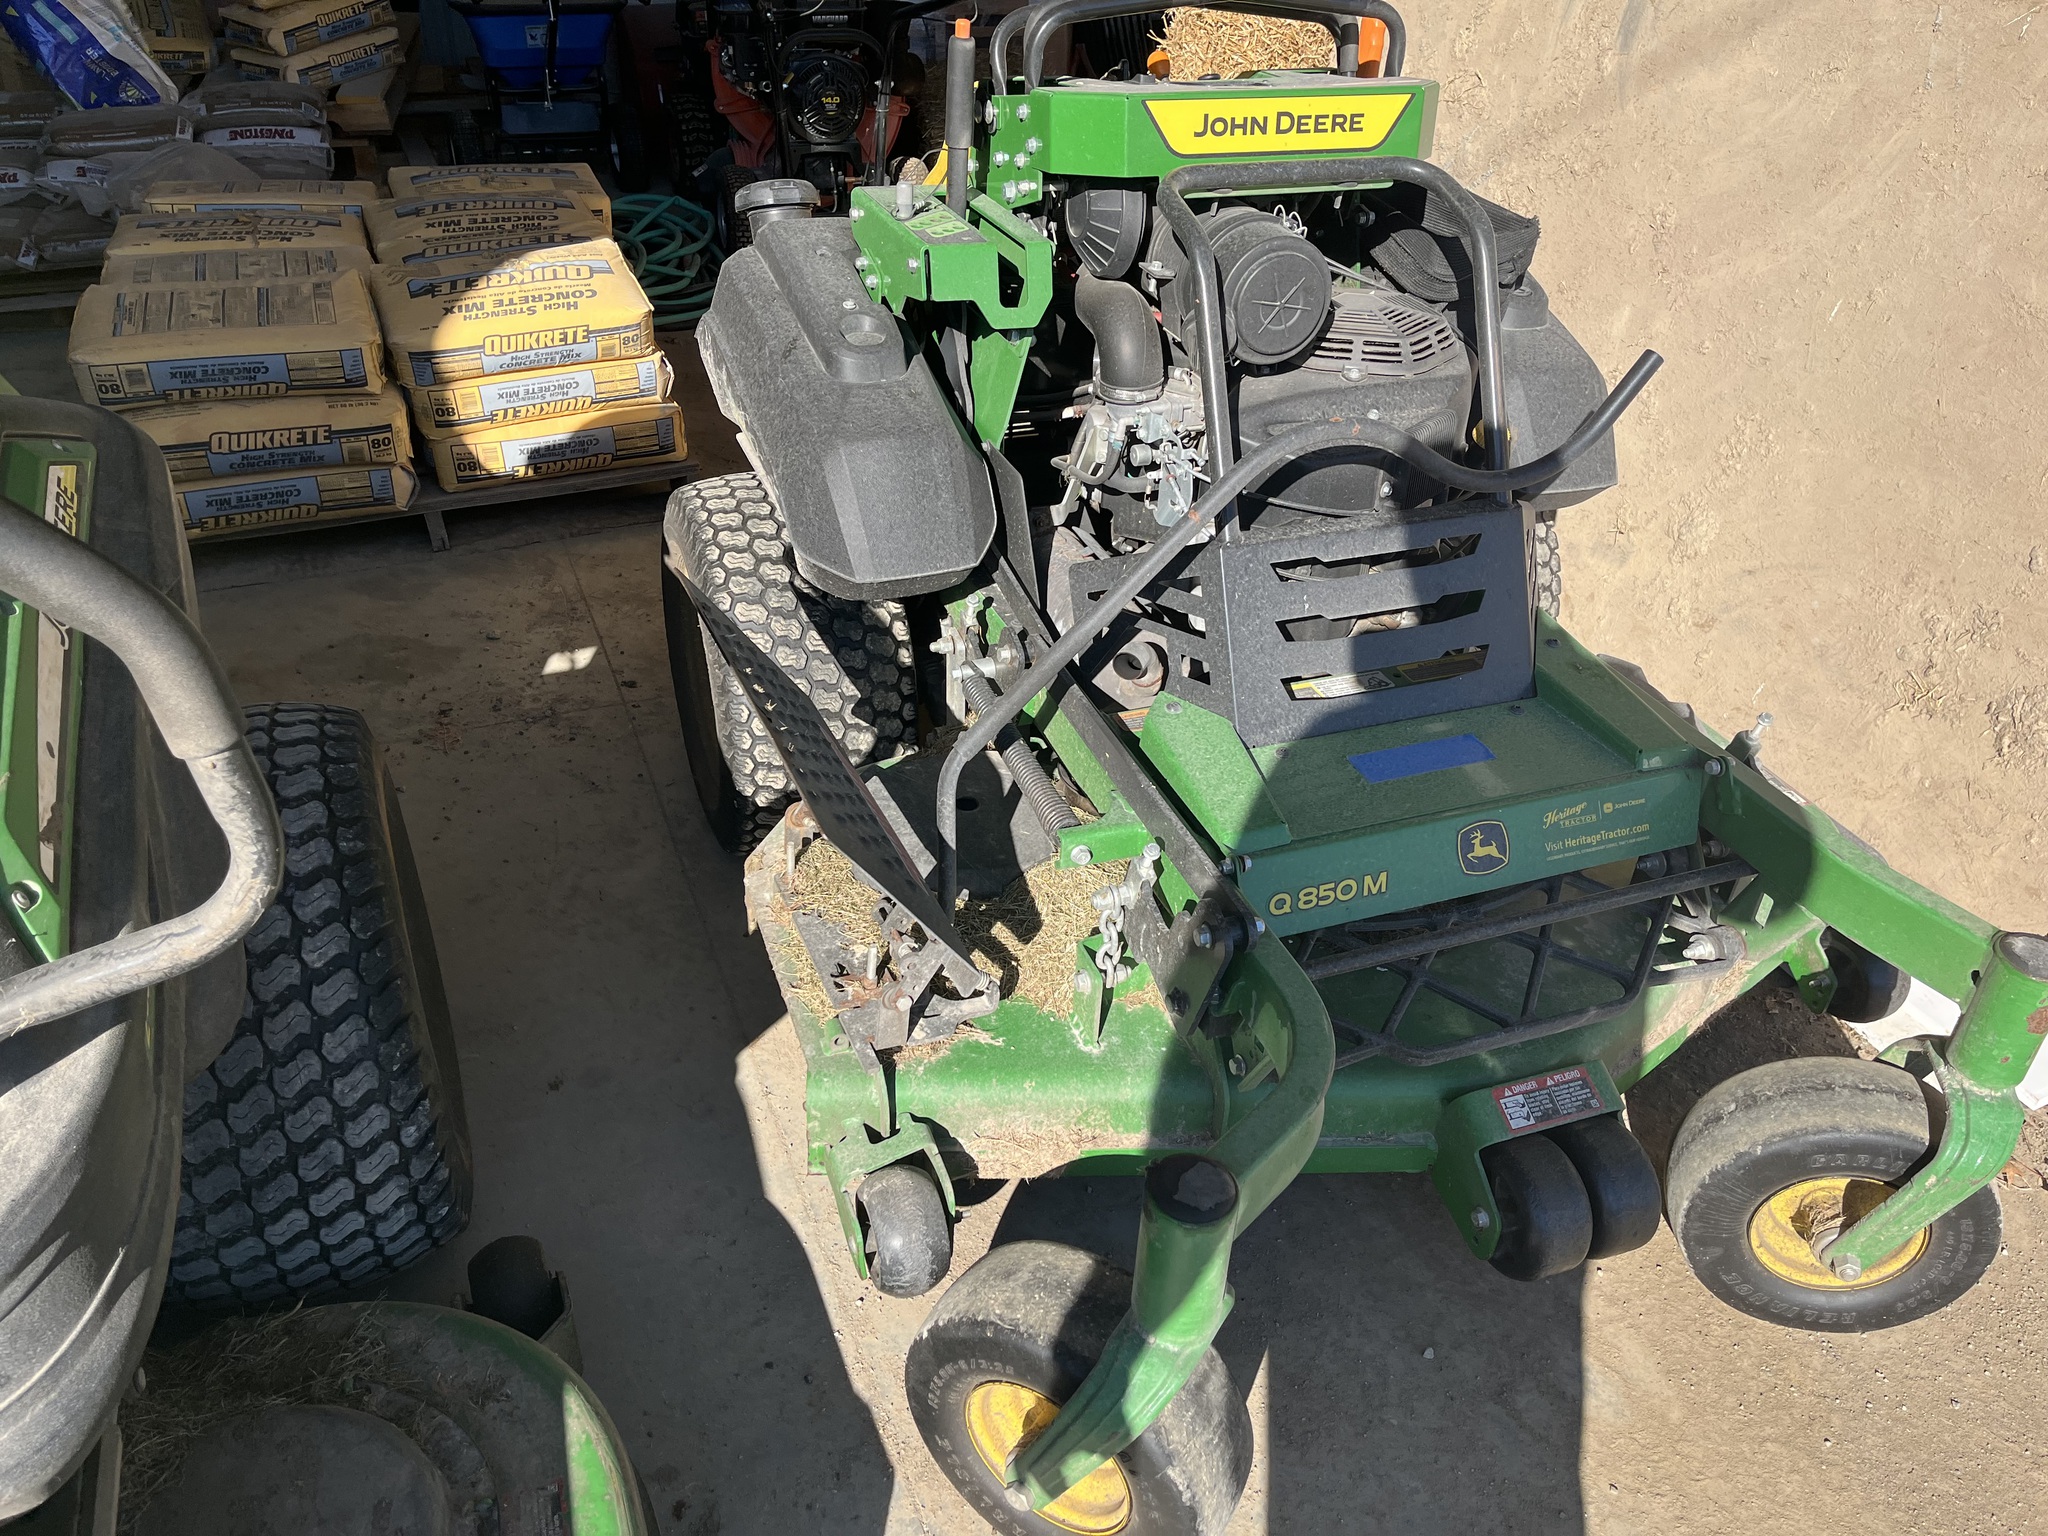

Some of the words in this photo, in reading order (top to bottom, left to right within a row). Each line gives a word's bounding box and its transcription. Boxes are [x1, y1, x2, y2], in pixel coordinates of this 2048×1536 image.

[315, 1, 367, 27] QUIKRETE
[328, 42, 377, 67] QUIKRETE
[1193, 113, 1268, 138] JOHN
[1275, 111, 1365, 134] DEERE
[415, 200, 558, 217] QUIKRETE
[425, 218, 461, 230] MIX
[468, 214, 559, 224] CONCRETE
[442, 224, 506, 234] STRENGTH
[511, 222, 541, 230] HIGH
[430, 264, 592, 298] QUIKRETE
[492, 289, 598, 308] CONCRETE
[441, 302, 485, 316] MIX
[543, 301, 579, 311] HIGH
[463, 306, 538, 321] STRENGTH
[483, 325, 590, 357] QUIKRETE
[622, 334, 639, 346] 80
[510, 354, 530, 362] HIGH
[532, 349, 574, 359] STRENGTH
[499, 358, 558, 369] CONCRETE
[169, 369, 196, 379] MIX
[201, 365, 270, 376] CONCRETE
[180, 376, 229, 385] STRENGTH
[232, 374, 256, 382] HIGH
[98, 384, 121, 395] 80
[164, 382, 287, 400] QUIKRETE
[497, 390, 520, 400] MIX
[524, 381, 580, 396] CONCRETE
[550, 390, 569, 398] HIGH
[506, 394, 547, 404] STRENGTH
[436, 406, 456, 418] 80
[491, 395, 593, 424] QUIKRETE
[209, 424, 331, 454] QUIKRETE
[371, 437, 392, 450] 80
[544, 437, 600, 453] CONCRETE
[241, 453, 264, 462] HIGH
[268, 450, 316, 460] STRENGTH
[518, 444, 542, 456] MIX
[527, 448, 568, 460] STRENGTH
[229, 458, 296, 470] CONCRETE
[300, 454, 326, 463] MIX
[457, 461, 478, 472] 80
[511, 452, 614, 480] QUIKRETE
[205, 496, 232, 508] MIX
[236, 488, 302, 503] CONCRETE
[267, 498, 290, 506] HIGH
[216, 502, 264, 512] STRENGTH
[200, 504, 320, 531] QUIKRETE
[1542, 801, 1588, 830] Heritage
[1560, 814, 1597, 829] TRACTOR
[1544, 840, 1564, 852] Visit
[1564, 823, 1650, 849] HeritageTractor.com
[1267, 891, 1294, 918] Q
[1296, 877, 1359, 911] 850
[1361, 871, 1389, 898] M
[1553, 1069, 1582, 1083] PELIGRO
[1511, 1080, 1539, 1094] DANGER
[1722, 1270, 1858, 1325] RELIANCE
